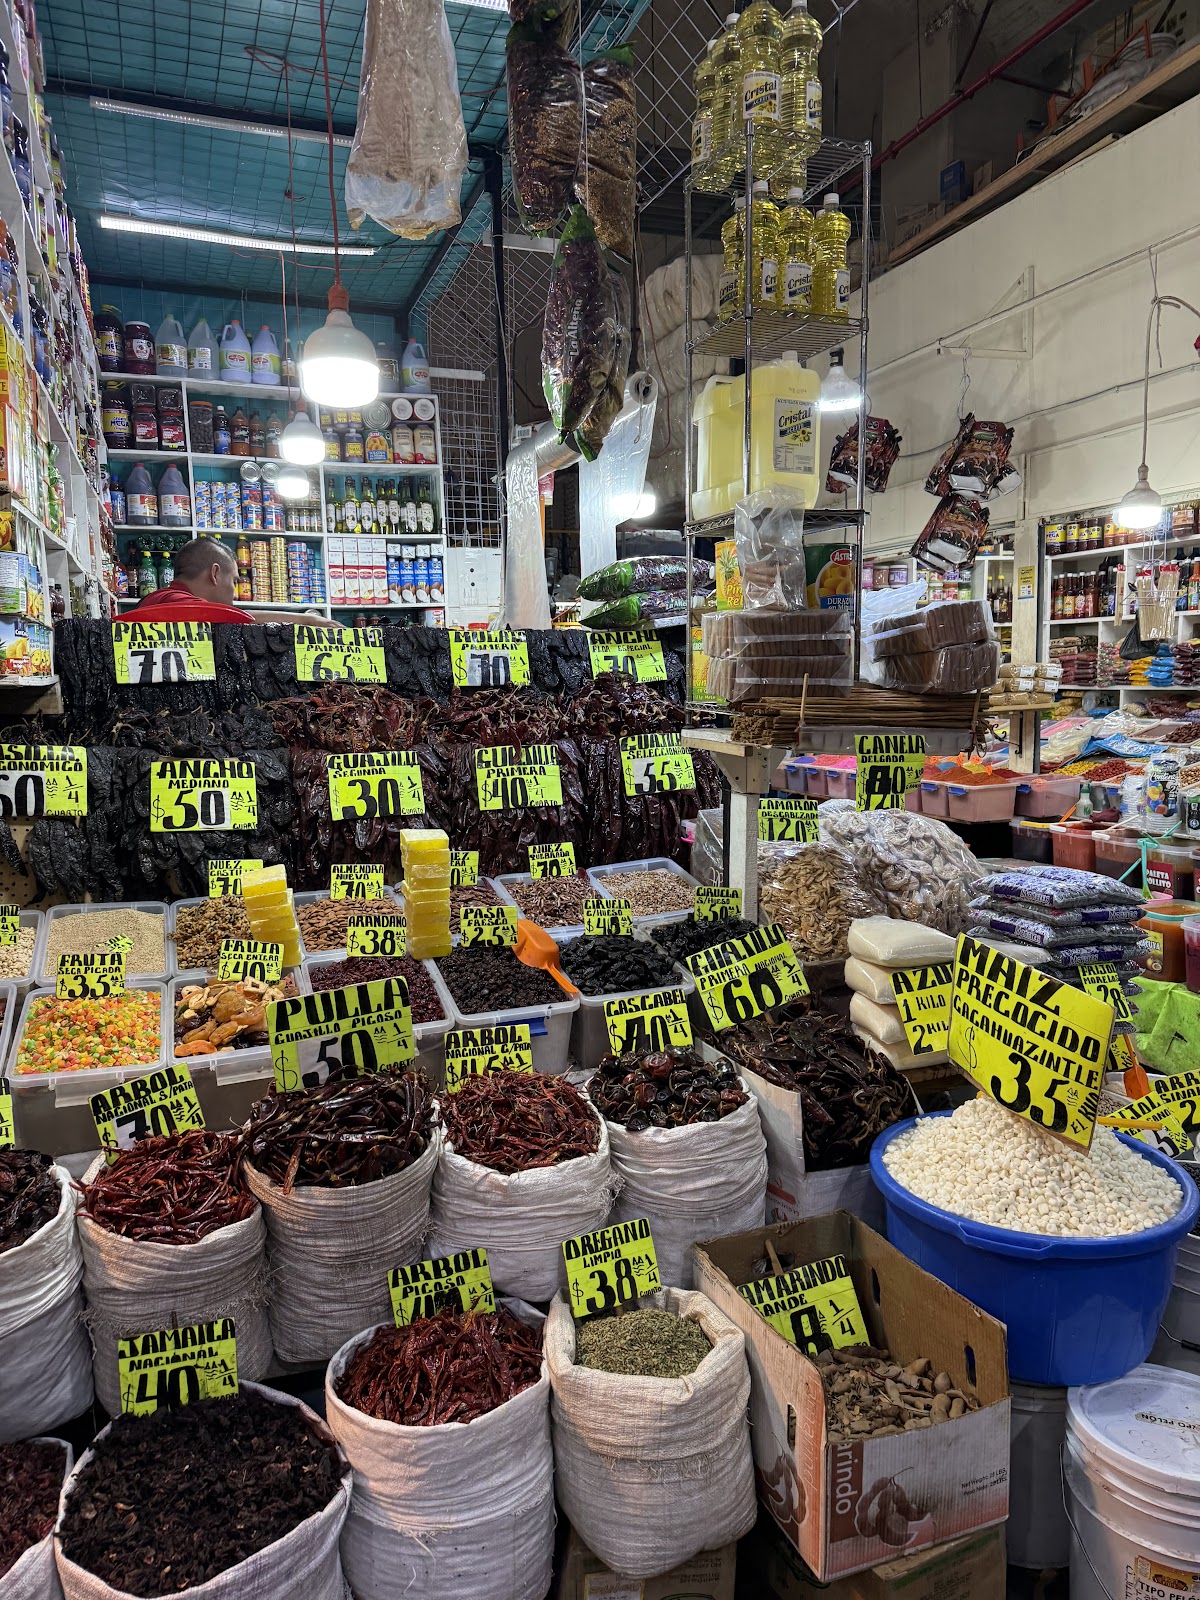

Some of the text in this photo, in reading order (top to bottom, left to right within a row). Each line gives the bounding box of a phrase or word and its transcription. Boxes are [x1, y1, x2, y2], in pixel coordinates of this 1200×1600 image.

[745, 80, 776, 102] Cristal
[779, 407, 812, 427] Cristal
[114, 622, 211, 642] PASILLA
[297, 625, 385, 648] ANCHO
[590, 630, 660, 644] ANCHO
[128, 641, 194, 649] PRIMERA
[306, 645, 361, 653] PRIMERA
[618, 643, 652, 651] ESPECIAL
[859, 735, 925, 754] CANELA
[861, 755, 904, 763] DELGADA
[157, 760, 253, 779] ANCHO
[333, 767, 386, 778] SEGUNDA
[487, 766, 546, 778] PRIMERA
[168, 779, 229, 789] MEDIANO
[533, 844, 562, 854] NUEZ
[210, 861, 241, 870] NUEZ
[333, 865, 384, 874] ALMENDRA
[1146, 869, 1169, 880] PALETA
[696, 887, 739, 898] CIRUELA
[463, 908, 505, 919] PASA
[585, 899, 631, 910] CIRUELA
[349, 916, 406, 928] ARANDANO
[224, 940, 280, 954] FRUTA
[59, 953, 122, 966] FRUTA
[58, 966, 121, 975] SECA PICADA
[700, 963, 750, 991] PRIMERA
[959, 936, 1064, 1016] MAIZ
[1081, 963, 1116, 977] FRIJOL
[276, 979, 410, 1032] PULLA
[606, 990, 687, 1017] CASCABEL
[916, 994, 946, 1011] KILO
[956, 968, 1101, 1063] PRECOCIDO
[275, 1010, 403, 1045] GUAJILLO PICOSO
[446, 1026, 522, 1049] ARBOL
[954, 995, 1099, 1090] CACAHUAZINTLE
[446, 1046, 496, 1059] NACIONAL
[91, 1067, 185, 1115] ARBOL
[95, 1095, 156, 1125] NACIONAL
[565, 1218, 651, 1261] OREGANO
[583, 1248, 622, 1268] LIMPIO
[391, 1249, 487, 1288] ARBOL
[402, 1276, 465, 1299] PICOSO
[119, 1318, 236, 1360] JAMAICA
[128, 1347, 218, 1371] NACIONAL
[1139, 1580, 1165, 1598] TIPO
